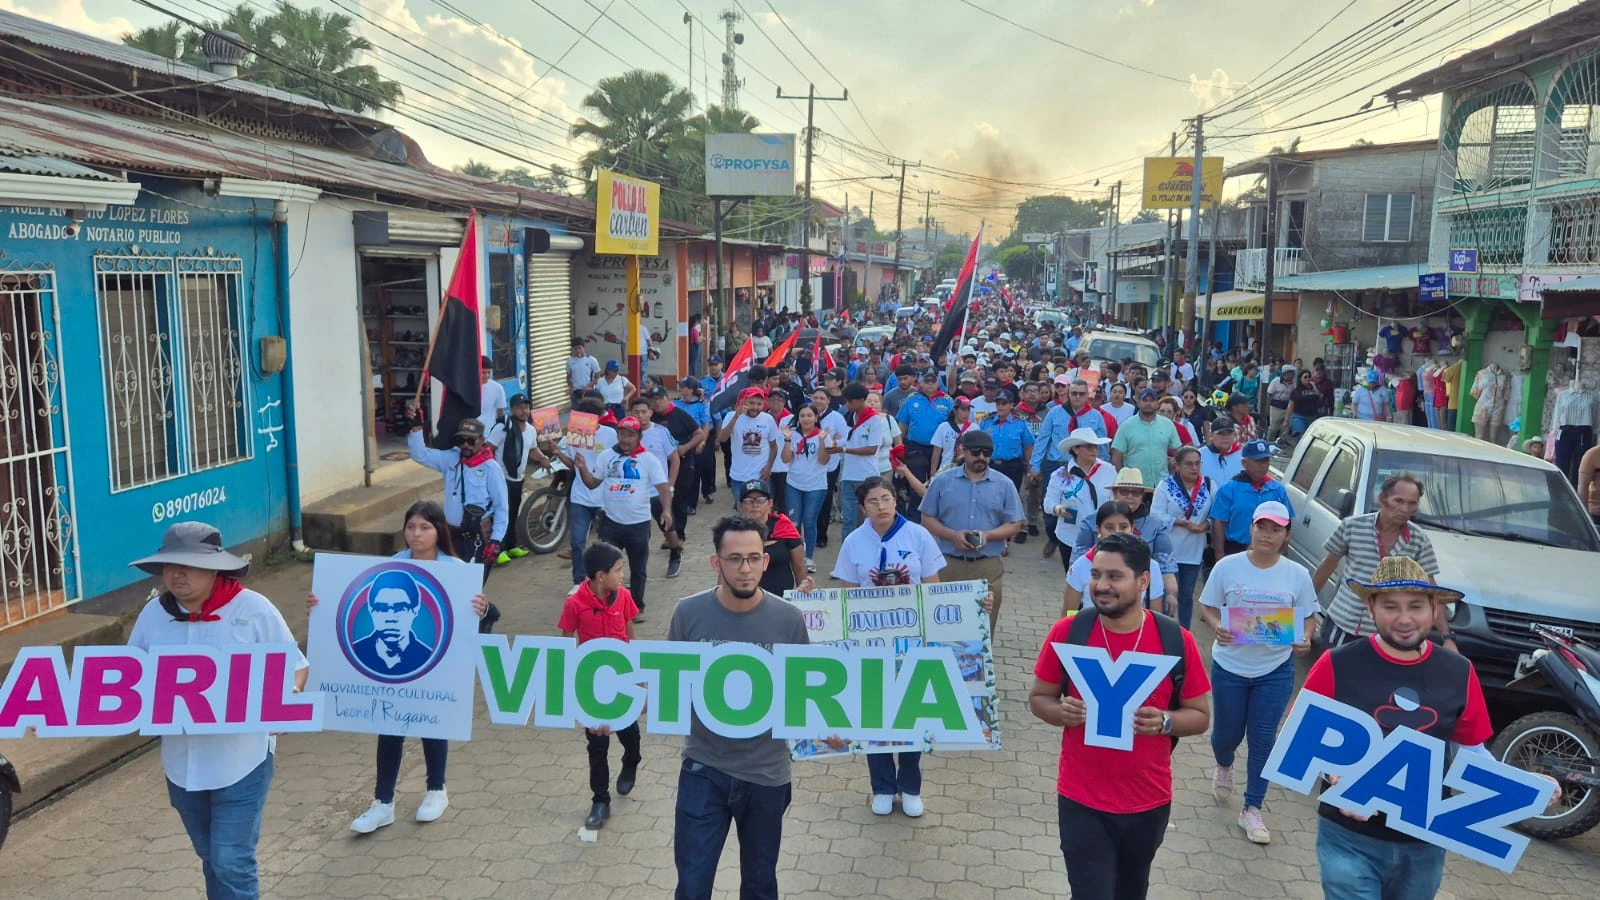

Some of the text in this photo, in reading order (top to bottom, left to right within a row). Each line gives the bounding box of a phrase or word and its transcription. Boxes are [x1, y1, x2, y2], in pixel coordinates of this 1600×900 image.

[724, 158, 790, 170] PROFYSA
[612, 179, 647, 214] POLLO AL
[108, 205, 146, 222] LOPEZ
[150, 207, 189, 225] FLORES
[8, 222, 69, 240] ABOGADO
[86, 226, 135, 243] NOTARIO
[138, 229, 181, 244] PUBLICO
[166, 485, 226, 518] 89076024
[0, 652, 314, 727] ABRIL
[319, 682, 457, 702] MOVIMIENTO CULTURAL
[481, 645, 968, 730] VICTORIA
[1072, 656, 1157, 739] Y
[334, 695, 440, 732] Leonel Rugama
[1279, 703, 1541, 860] PAZ
